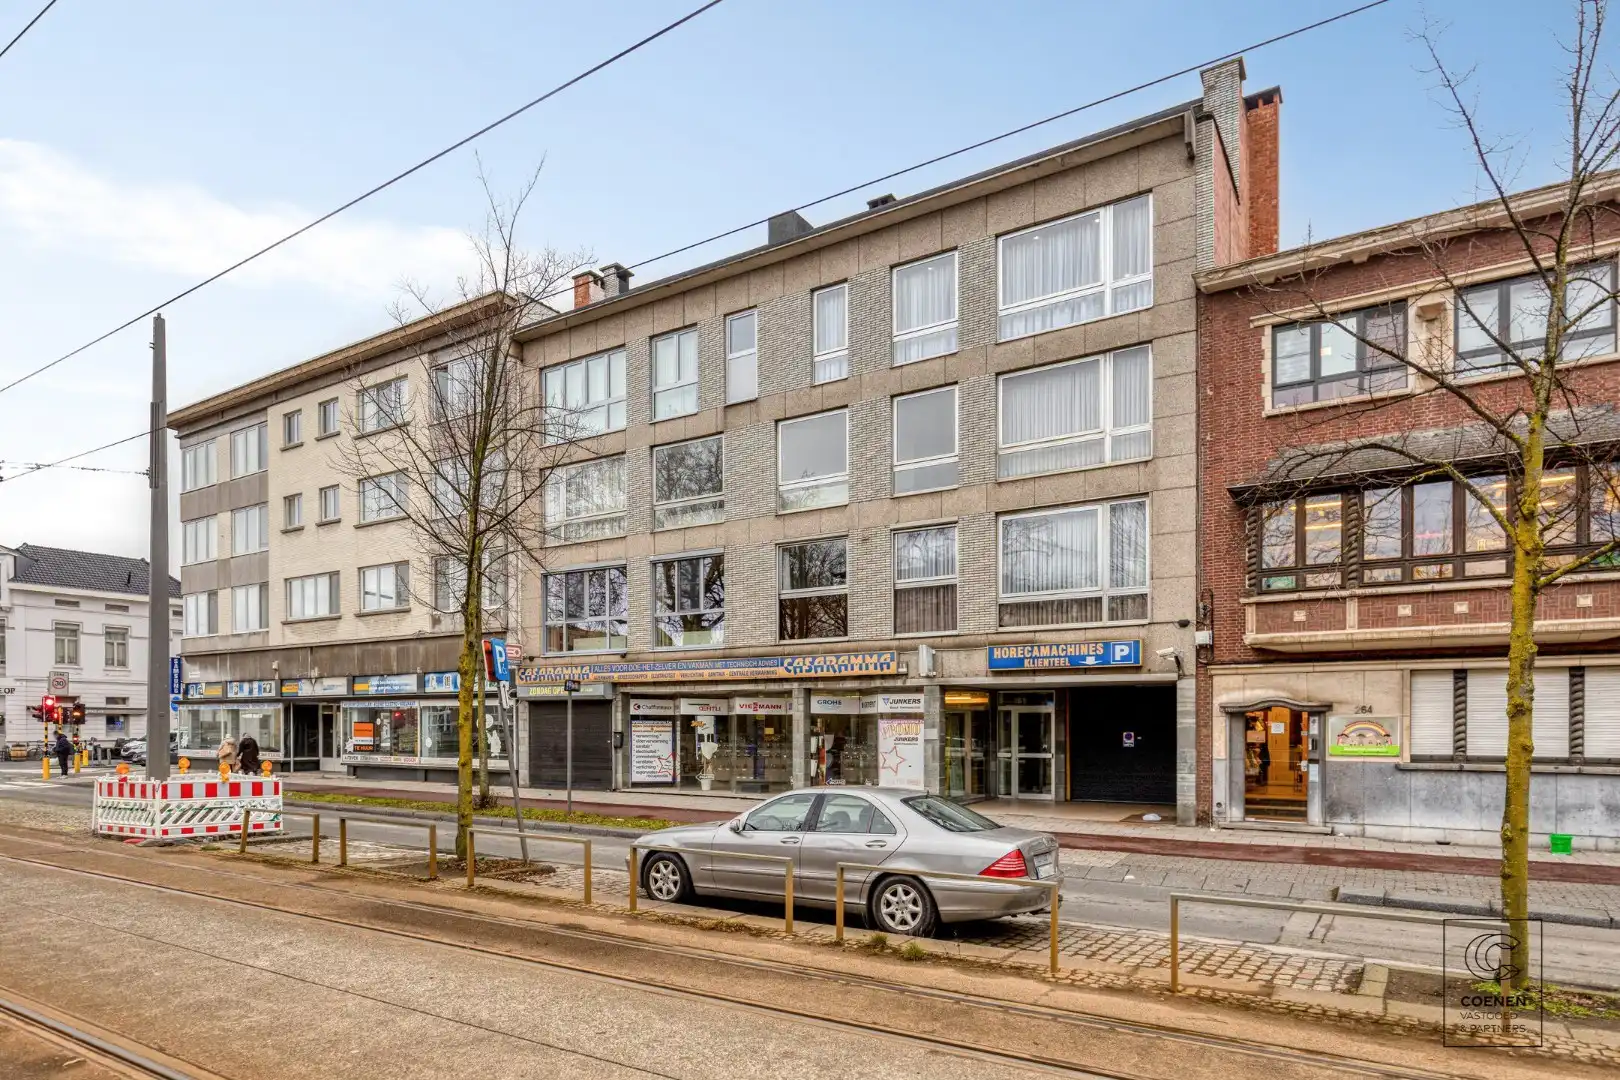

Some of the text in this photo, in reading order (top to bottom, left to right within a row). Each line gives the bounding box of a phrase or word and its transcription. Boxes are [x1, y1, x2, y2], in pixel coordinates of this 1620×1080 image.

[993, 643, 1104, 659] HORECAMACHINES
[1114, 645, 1130, 661] P
[494, 645, 506, 674] P
[594, 664, 611, 673] ALLES
[612, 663, 628, 672] VOOR
[758, 659, 778, 667] ADVIES
[783, 652, 892, 675] CASARAMMA
[1023, 657, 1070, 668] KLIENTEEL
[172, 658, 180, 694] SAMSUNG
[518, 665, 590, 682] CASARAMMA
[3, 687, 16, 695] OP
[1354, 705, 1373, 715] 264
